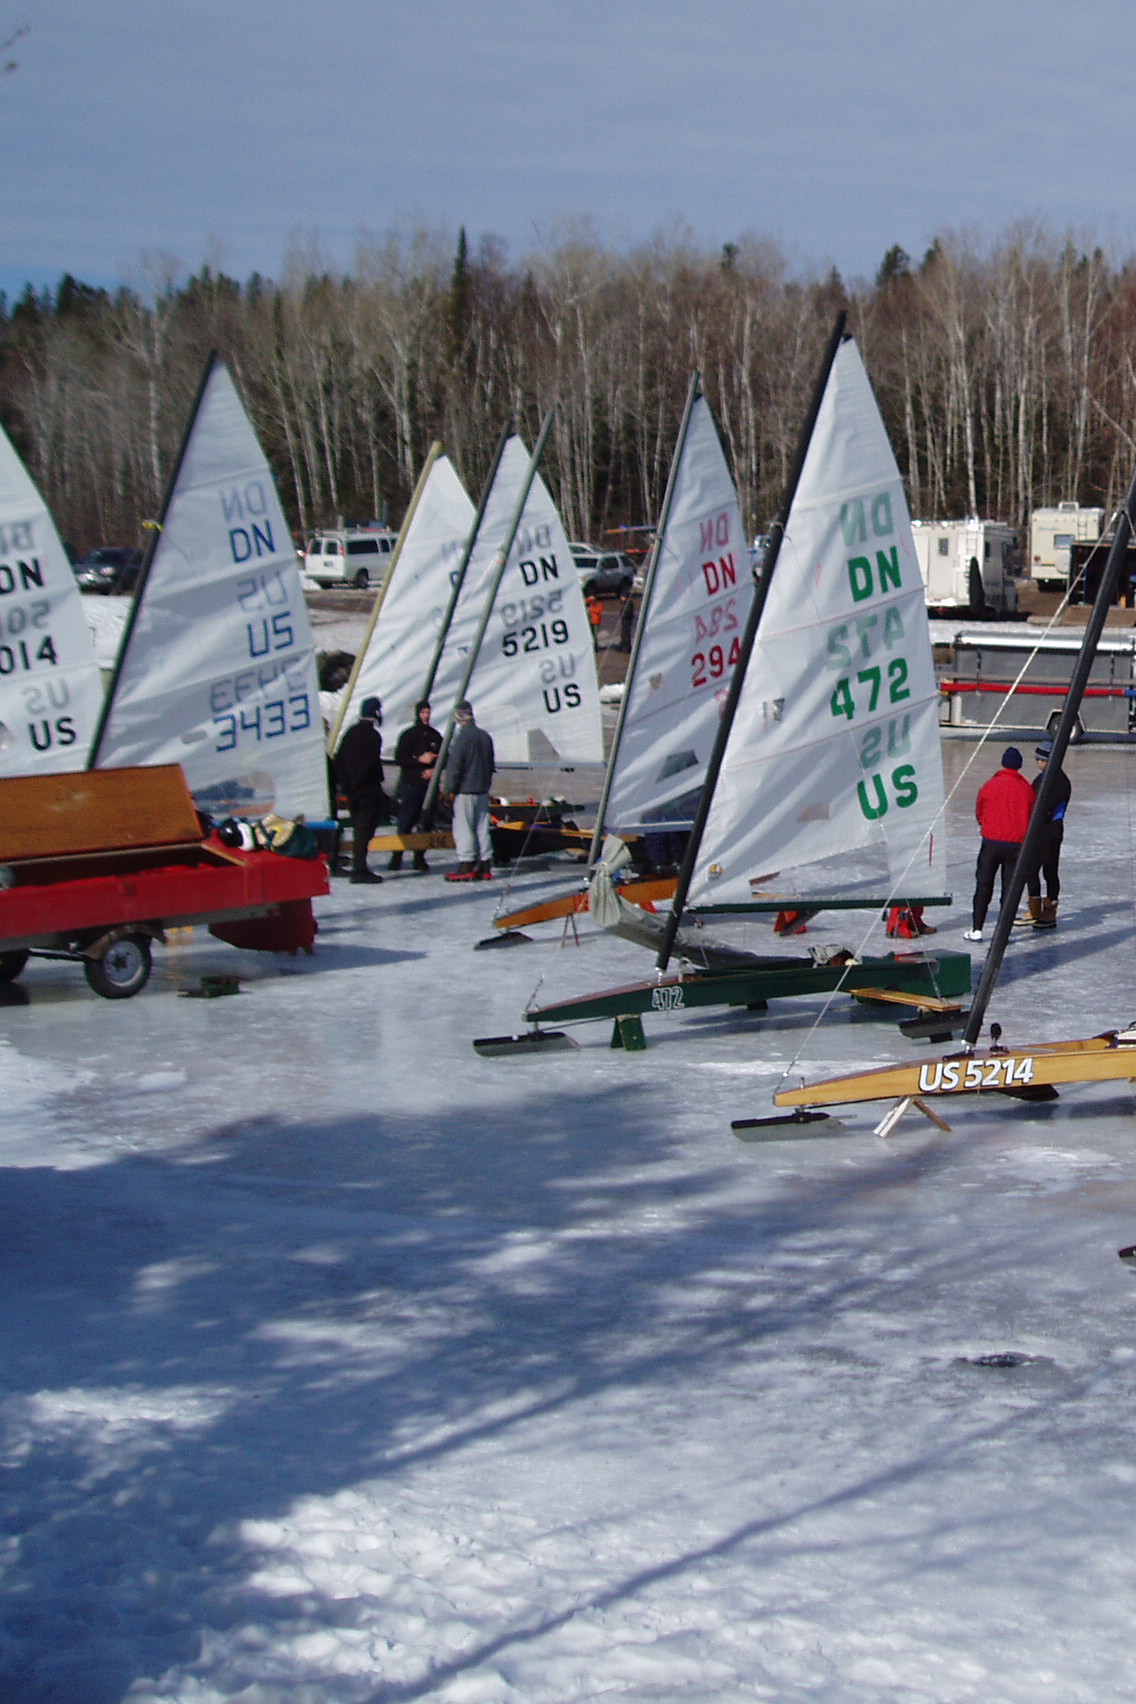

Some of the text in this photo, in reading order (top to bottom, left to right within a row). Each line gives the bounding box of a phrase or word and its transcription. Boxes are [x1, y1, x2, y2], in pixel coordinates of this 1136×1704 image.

[229, 519, 276, 563] DN
[519, 554, 560, 587] DN
[702, 553, 737, 596] DN
[848, 545, 902, 602] DN
[248, 610, 294, 657] US
[502, 619, 569, 657] 5219
[691, 635, 743, 687] 294
[543, 683, 581, 714] US
[831, 658, 911, 720] 472
[28, 716, 77, 751] US
[213, 693, 310, 752] 3433
[857, 763, 918, 820] US
[919, 1057, 1034, 1092] US 5214
